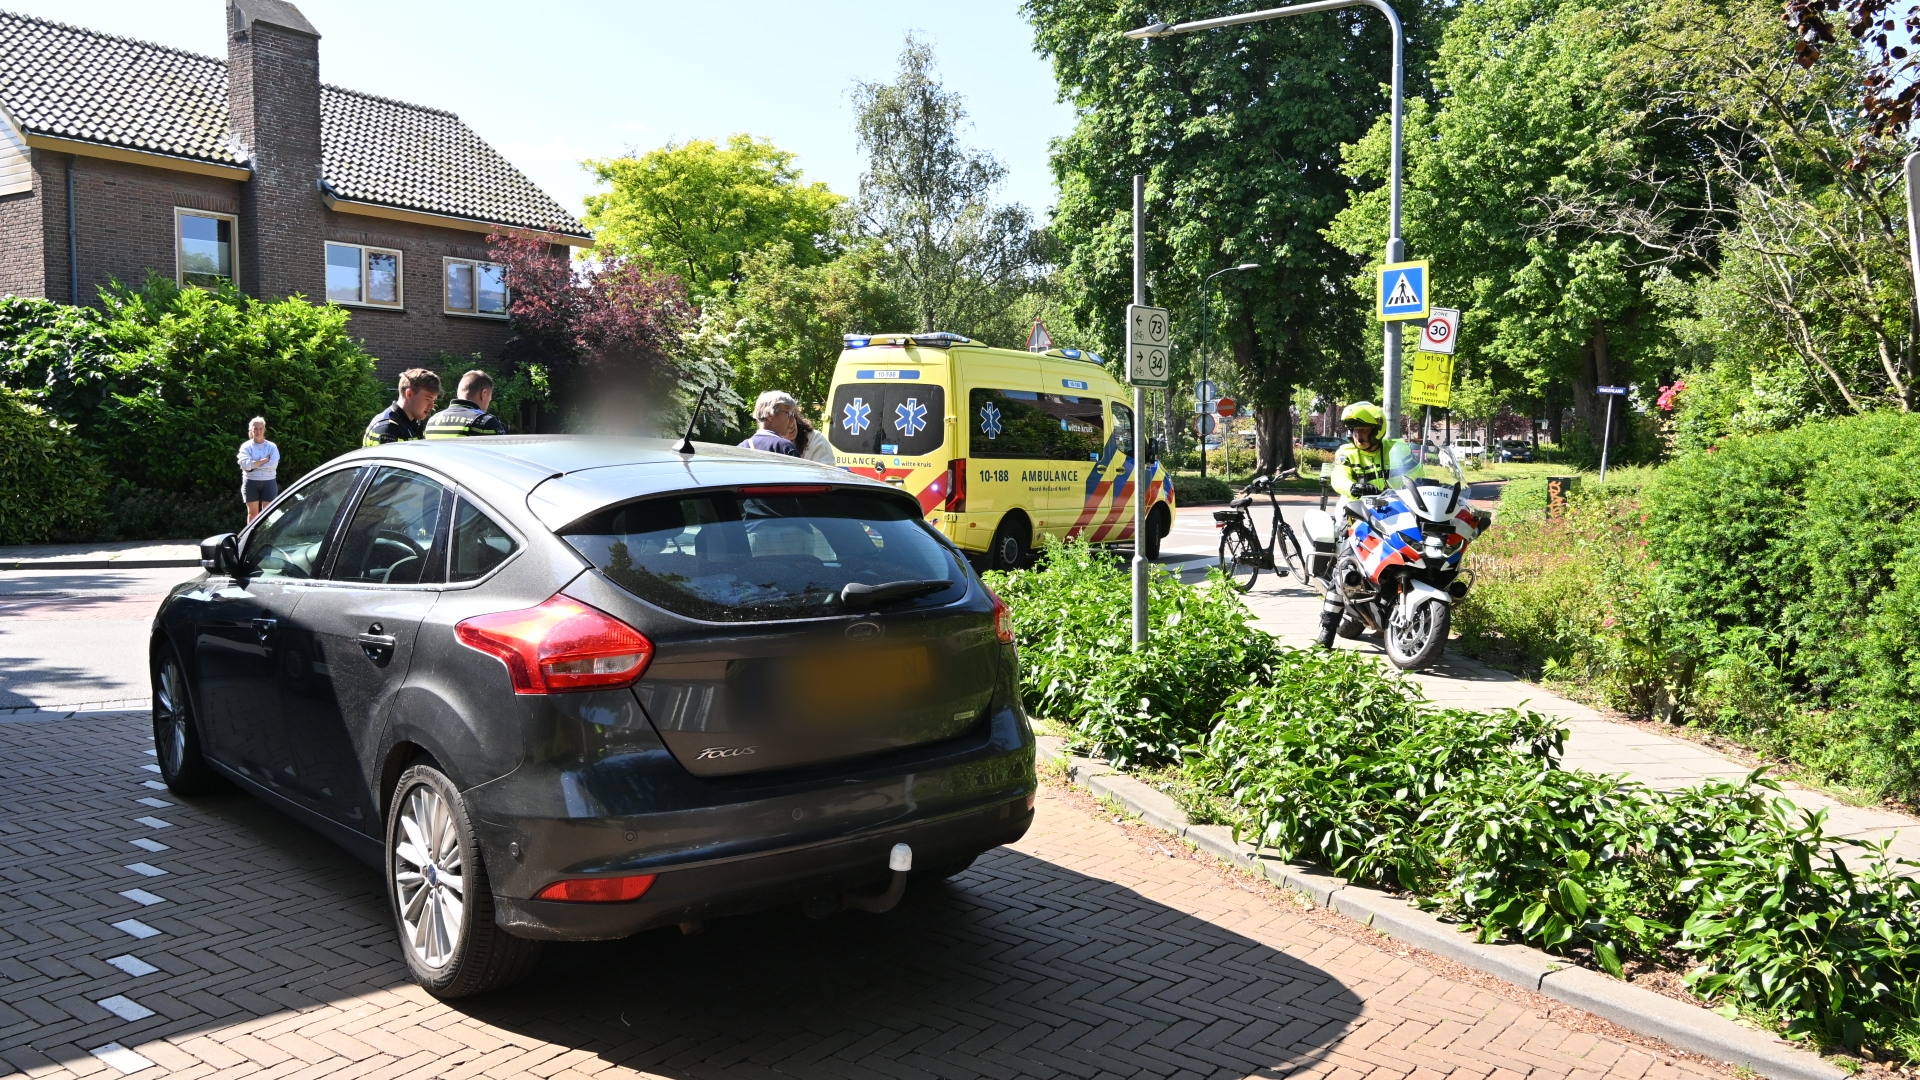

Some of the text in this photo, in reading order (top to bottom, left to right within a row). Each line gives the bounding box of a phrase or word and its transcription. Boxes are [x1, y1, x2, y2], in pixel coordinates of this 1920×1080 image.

[1151, 320, 1162, 334] 73
[1430, 325, 1447, 336] 30
[1151, 356, 1163, 370] 34
[1081, 424, 1093, 433] kruis
[836, 456, 876, 465] BULANCE
[979, 469, 1079, 482] 10-188 AMBULANCE
